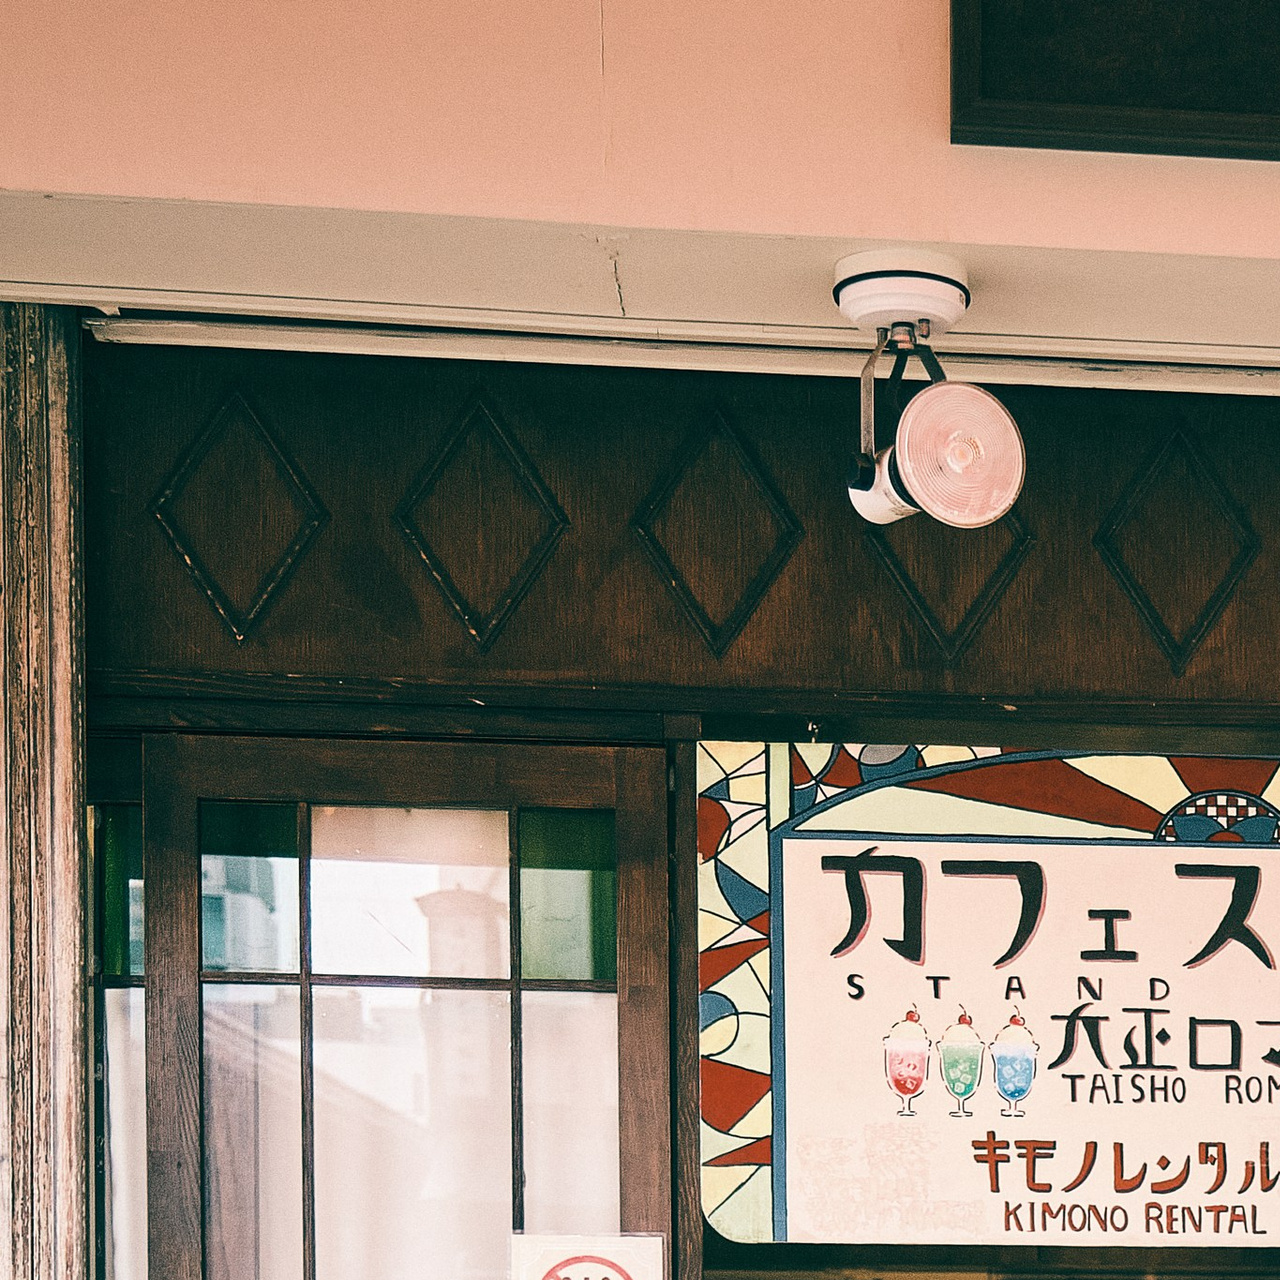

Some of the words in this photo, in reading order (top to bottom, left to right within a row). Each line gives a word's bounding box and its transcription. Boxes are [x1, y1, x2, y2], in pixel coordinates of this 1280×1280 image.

[846, 975, 1171, 1001] STAND
[1061, 1074, 1187, 1105] TAISHO
[970, 1131, 1280, 1195] キモノレンタル
[1004, 1201, 1130, 1236] KIMONO
[1145, 1201, 1268, 1236] RENTAL
